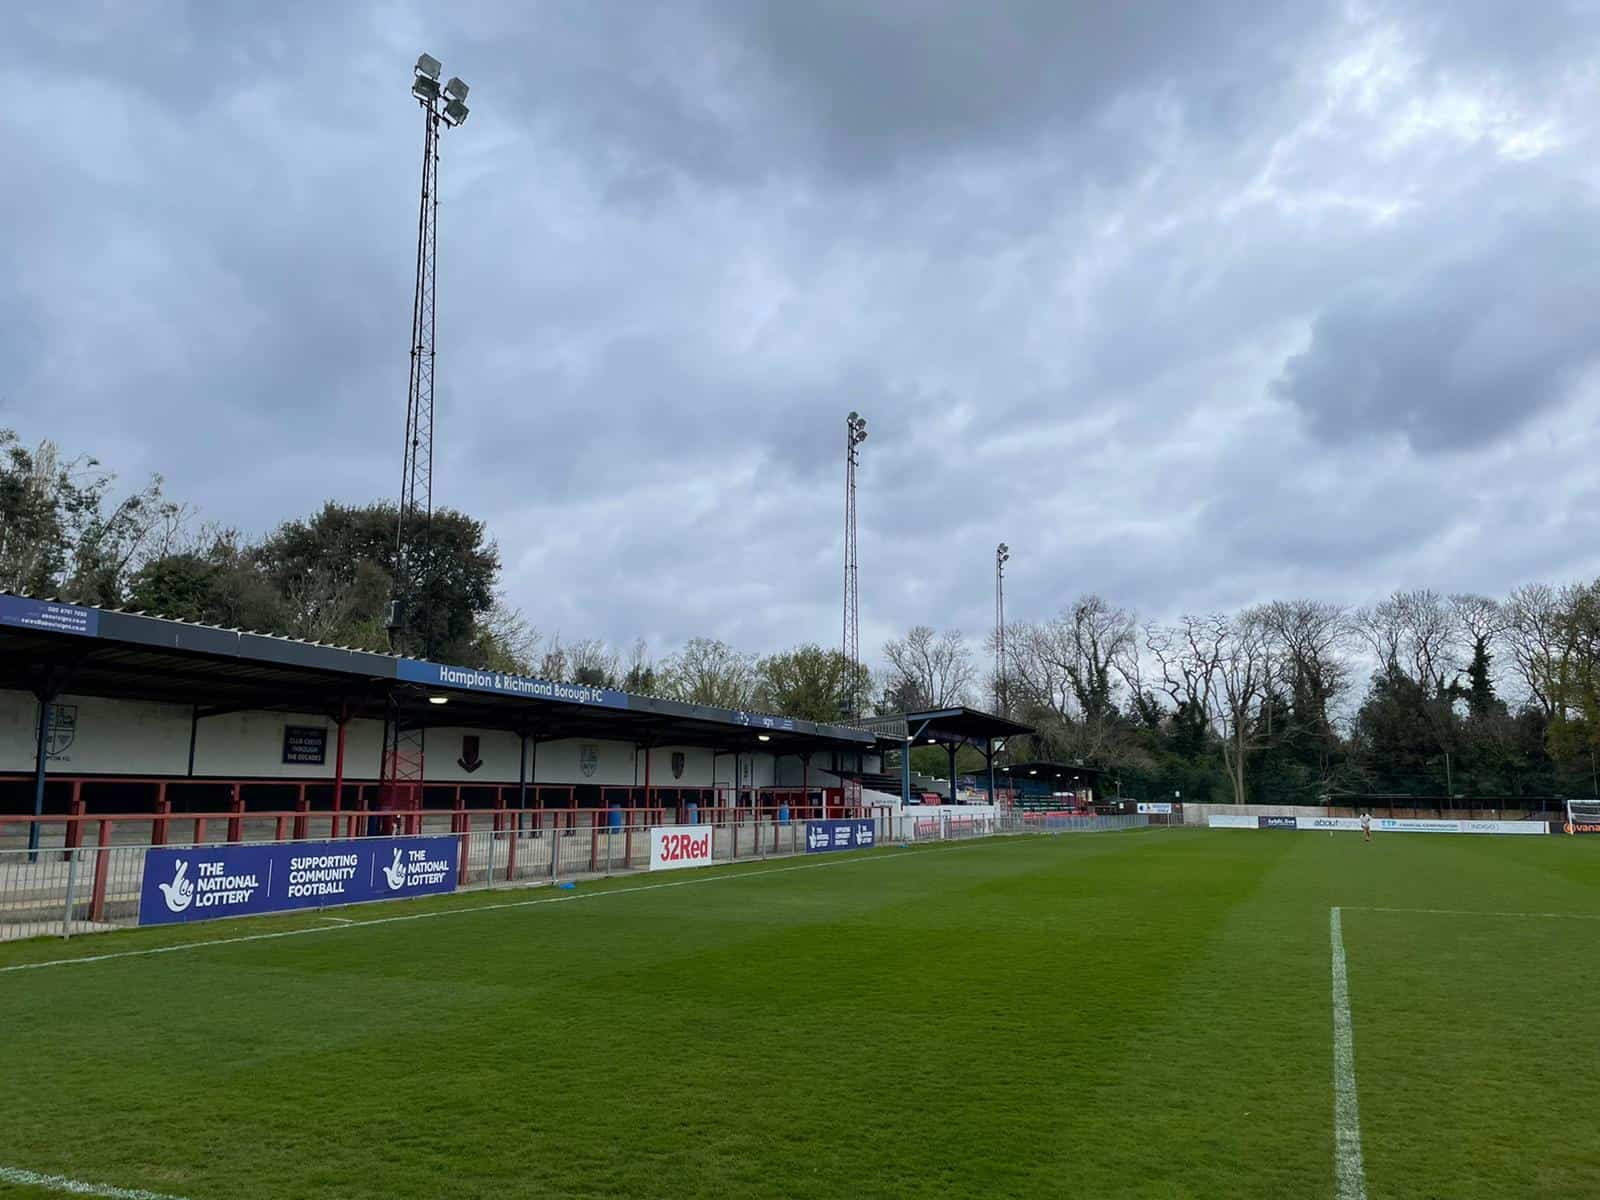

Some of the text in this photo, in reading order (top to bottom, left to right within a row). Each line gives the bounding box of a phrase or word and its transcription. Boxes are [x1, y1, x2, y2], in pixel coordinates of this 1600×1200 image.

[439, 665, 603, 703] Hampton & Richmond Borough FC
[408, 850, 426, 861] THE
[661, 833, 708, 862] 32Red
[198, 862, 224, 876] THE
[290, 854, 358, 870] SUPPORTING
[408, 860, 449, 874] NATIONAL
[197, 875, 259, 891] NATIONAL
[289, 867, 356, 883] COMMUNITY
[407, 872, 445, 886] LOTTERY
[288, 882, 344, 897] FOOTBALL
[195, 890, 252, 907] LOTTERY
